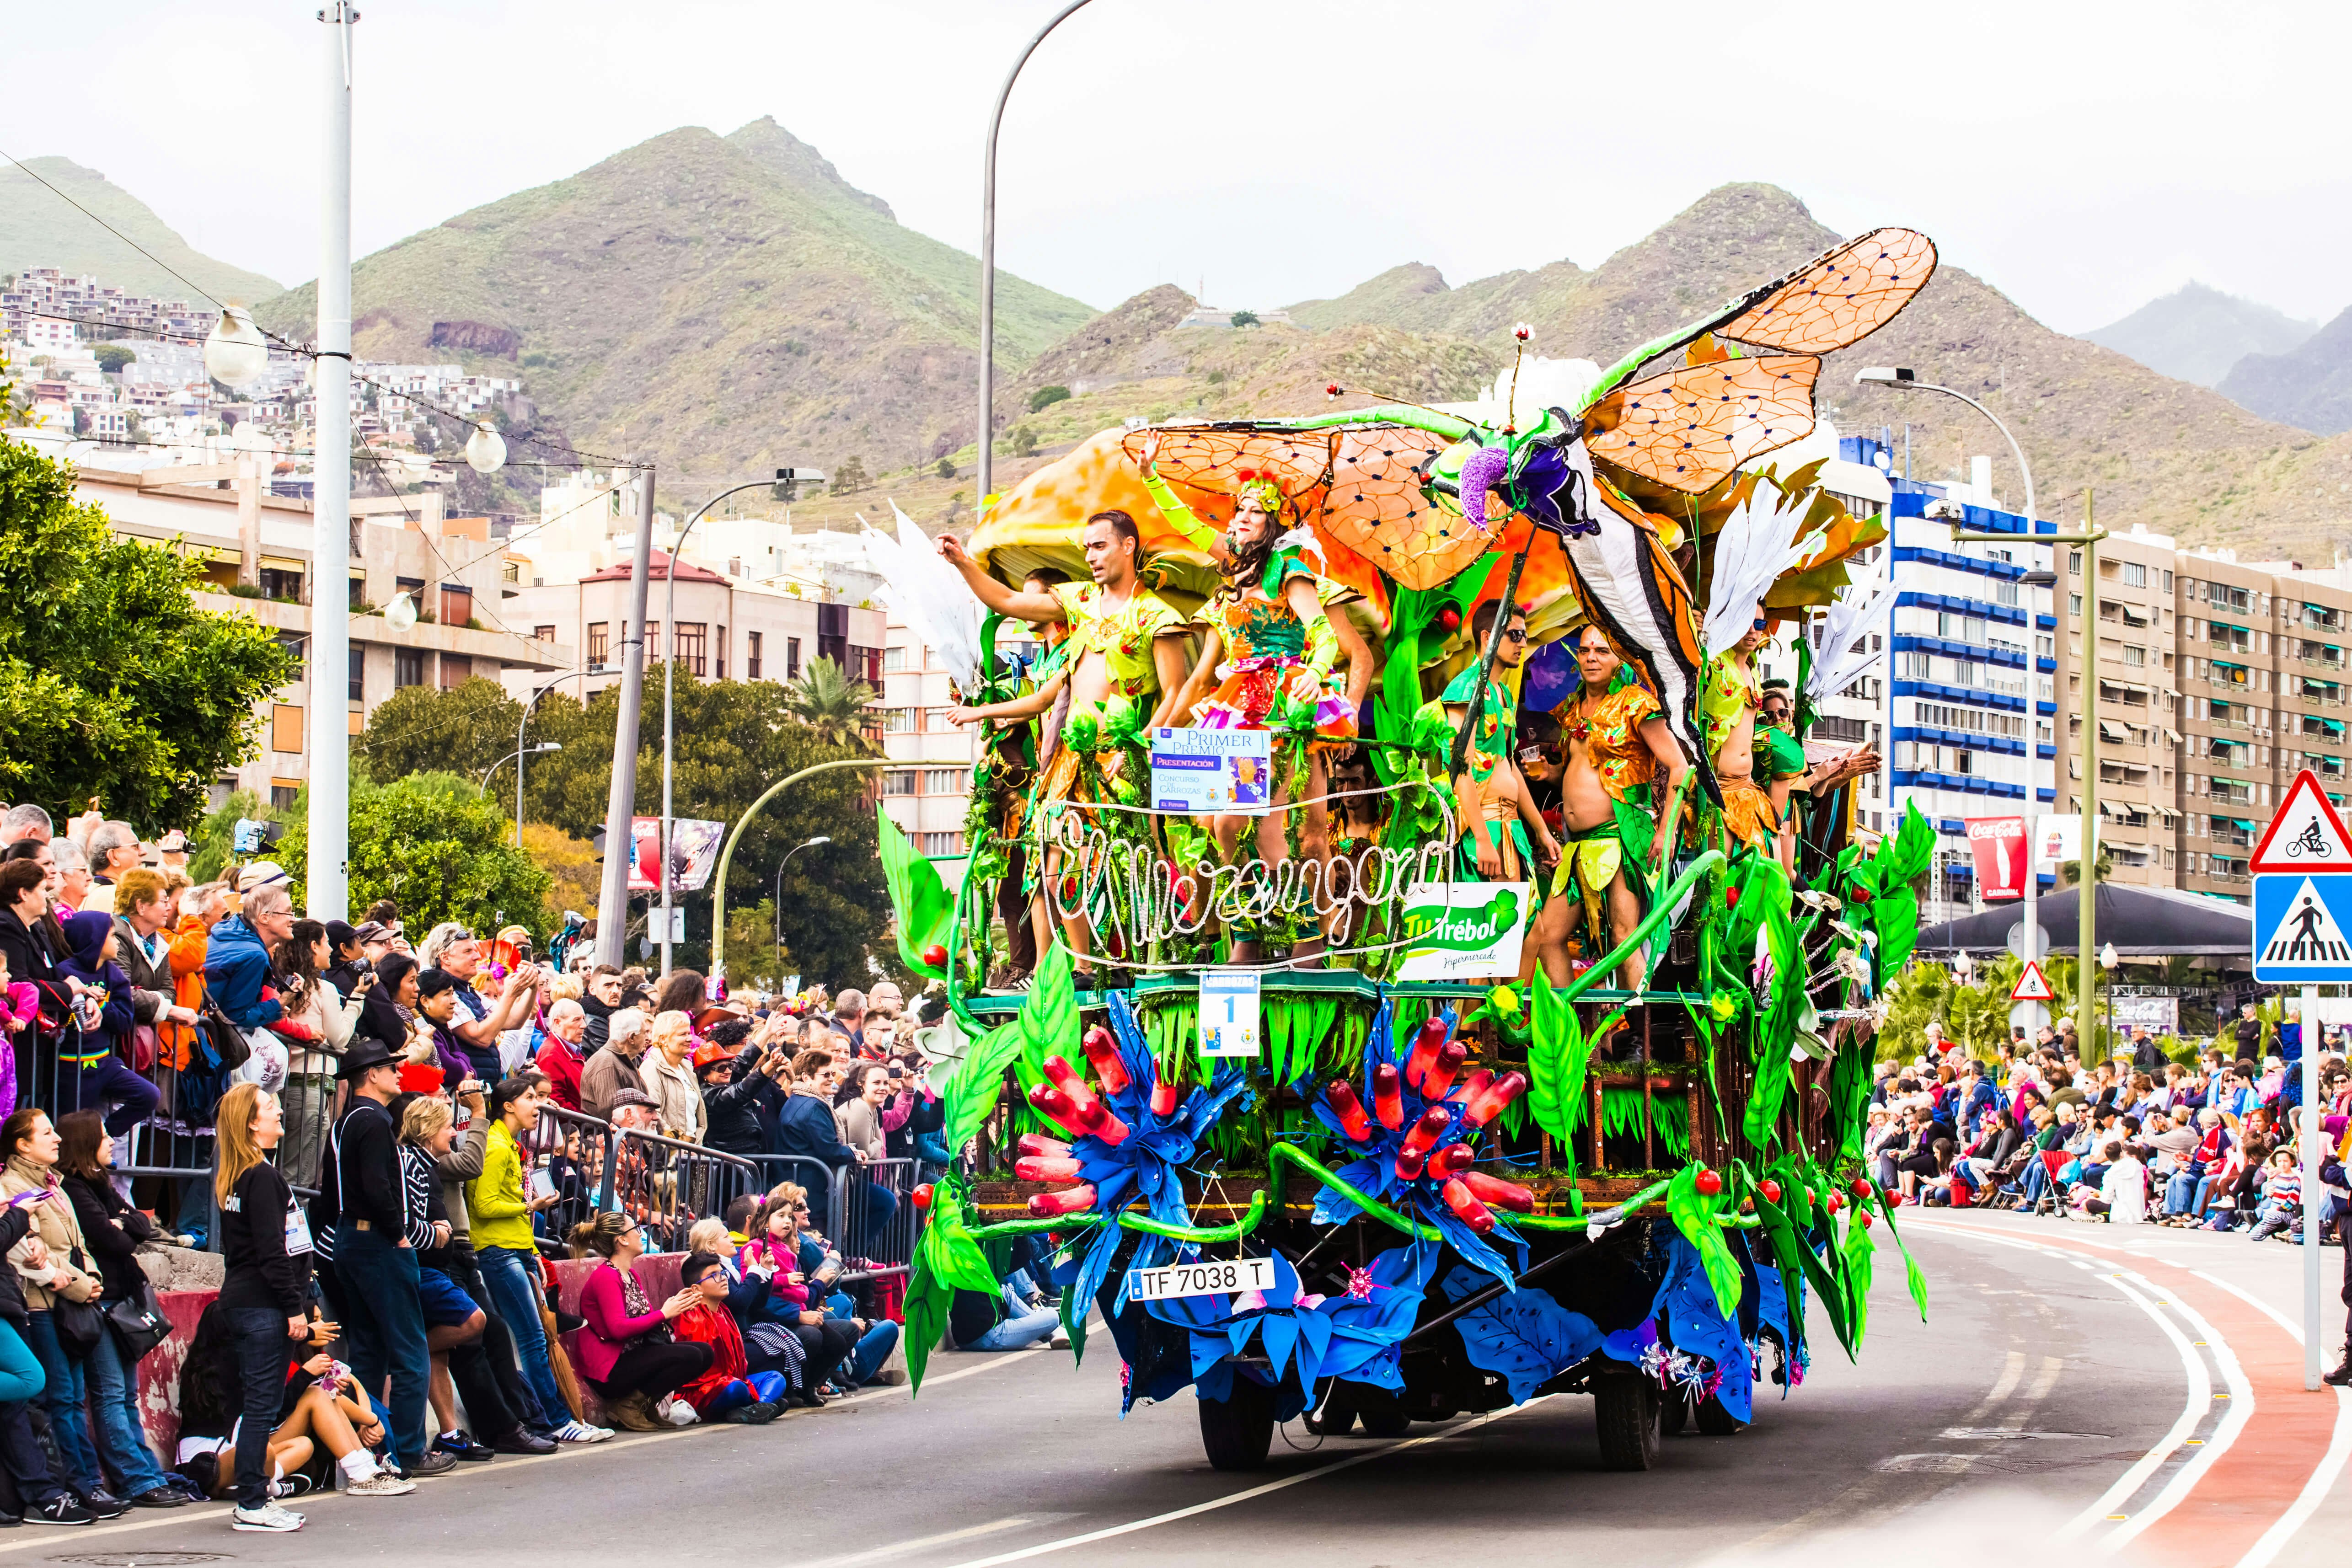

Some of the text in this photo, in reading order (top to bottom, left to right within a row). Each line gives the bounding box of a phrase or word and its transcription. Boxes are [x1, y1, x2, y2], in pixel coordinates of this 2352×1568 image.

[1188, 730, 1252, 747] PRIMER
[1173, 742, 1225, 755] PREMIO
[1157, 757, 1214, 768] PRESENTACIÓN
[1158, 774, 1200, 783] CONCURSO
[1159, 784, 1201, 794] CARROZAS
[1986, 888, 2020, 897] CARNAVAL
[1443, 949, 1497, 971] Hipermercado
[1223, 995, 1235, 1023] 1
[225, 1192, 241, 1213] CIÓN
[1143, 1263, 1263, 1295] TF 7038 T
